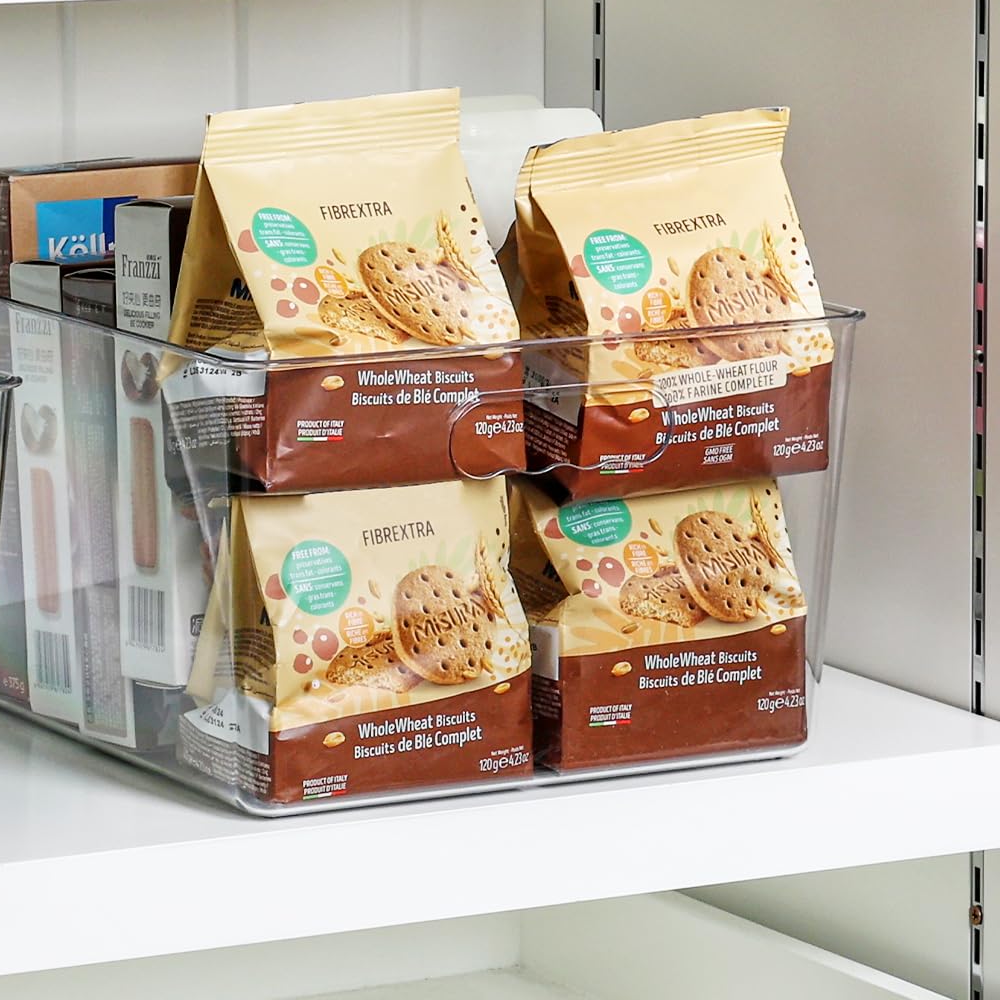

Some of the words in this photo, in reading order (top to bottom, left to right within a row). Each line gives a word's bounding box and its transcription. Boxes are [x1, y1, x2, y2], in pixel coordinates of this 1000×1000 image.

[320, 201, 392, 220] FIBREXTRA
[654, 213, 727, 237] FIBREXTRA
[121, 254, 161, 280] Franzzi
[16, 312, 52, 336] Franzzi
[358, 369, 432, 386] WholeWheat
[436, 371, 475, 384] Biscuits
[680, 364, 748, 387] WHOLE-WHEAT
[750, 360, 778, 376] FLOUR
[352, 392, 393, 406] Biscuits
[396, 389, 411, 404] de
[414, 388, 431, 403] Blé
[433, 387, 481, 406] Complet
[687, 383, 723, 400] FARINE
[661, 403, 734, 427] WholeWheat
[737, 402, 775, 416] Biscuits
[297, 420, 322, 428] PRODUCT
[330, 420, 344, 428] ITALY
[298, 429, 321, 437] PRODUIT
[655, 430, 697, 446] Biscuits
[699, 426, 714, 441] de
[716, 423, 733, 439] Blé
[734, 417, 780, 438] Complet
[704, 456, 718, 464] SANS
[719, 454, 733, 463] OGM
[705, 448, 718, 456] GMO
[719, 446, 733, 455] FREE
[362, 520, 435, 548] FIBREXTRA
[571, 521, 590, 534] SANS
[292, 549, 309, 561] FREE
[294, 583, 312, 593] SANS
[645, 654, 715, 670] WholeWheat
[719, 650, 757, 664] Biscuits
[639, 674, 678, 689] Biscuits
[681, 671, 695, 686] de
[697, 669, 714, 684] Blé
[716, 666, 762, 685] Complet
[590, 706, 612, 714] PRODUCT
[619, 704, 632, 712] ITALY
[590, 714, 612, 722] PRODUIT
[358, 716, 433, 739] WholeWheat
[436, 711, 476, 728] Biscuits
[354, 742, 395, 759] Biscuits
[397, 737, 412, 752] de
[414, 733, 433, 750] Blé
[435, 726, 483, 747] Complet
[303, 777, 326, 788] PRODUCT
[334, 774, 348, 783] ITALY
[303, 786, 325, 796] PRODUIT
